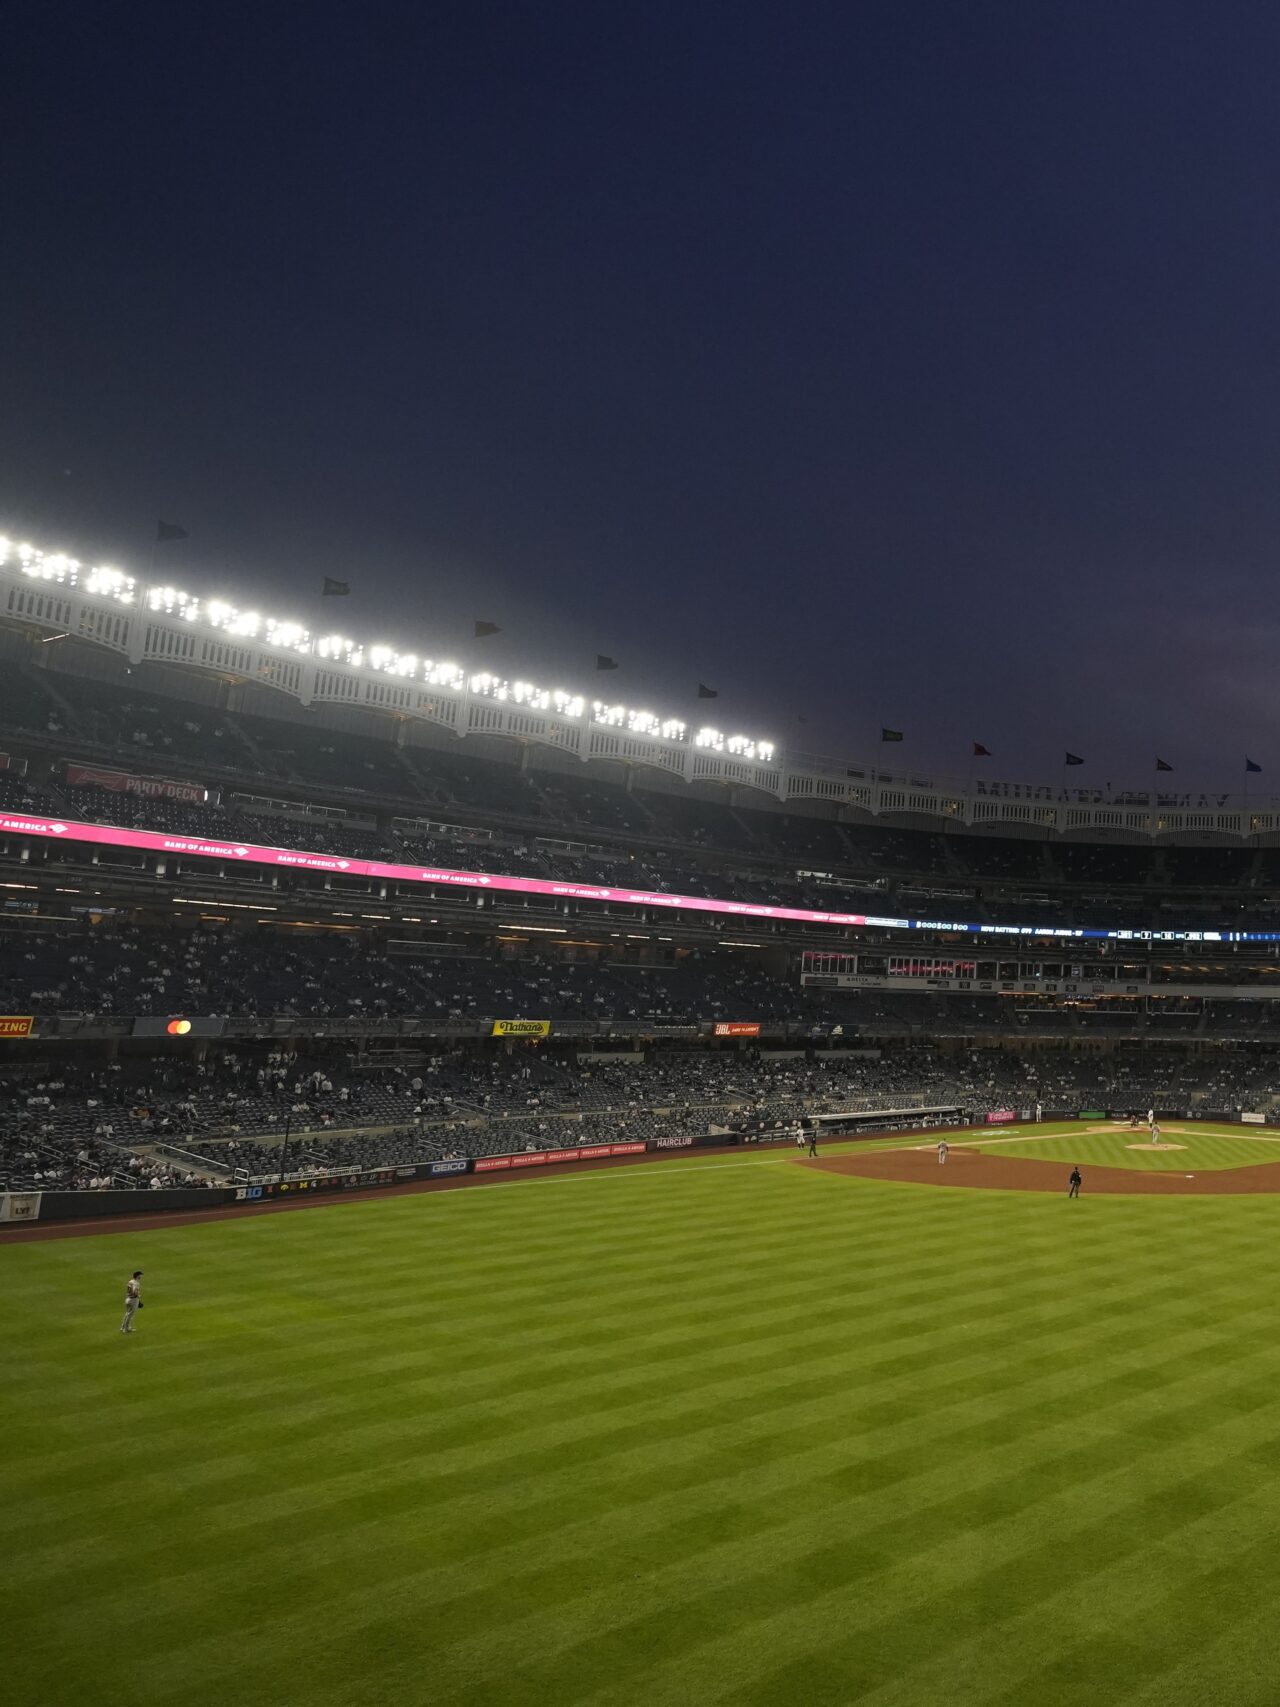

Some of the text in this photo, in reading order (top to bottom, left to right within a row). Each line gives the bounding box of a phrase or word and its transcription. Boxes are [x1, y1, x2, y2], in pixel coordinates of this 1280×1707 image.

[126, 778, 166, 796] PARTY
[167, 786, 198, 801] DECK
[4, 821, 47, 832] AMERICA
[164, 841, 232, 855] BANK OF AMERICA
[277, 855, 296, 863] BANK
[307, 859, 336, 868] AMERICA
[450, 876, 478, 884] AMERICA
[715, 1024, 731, 1035] JBL
[657, 1137, 692, 1148] HAIRCLUB
[432, 1162, 466, 1173] GEICO
